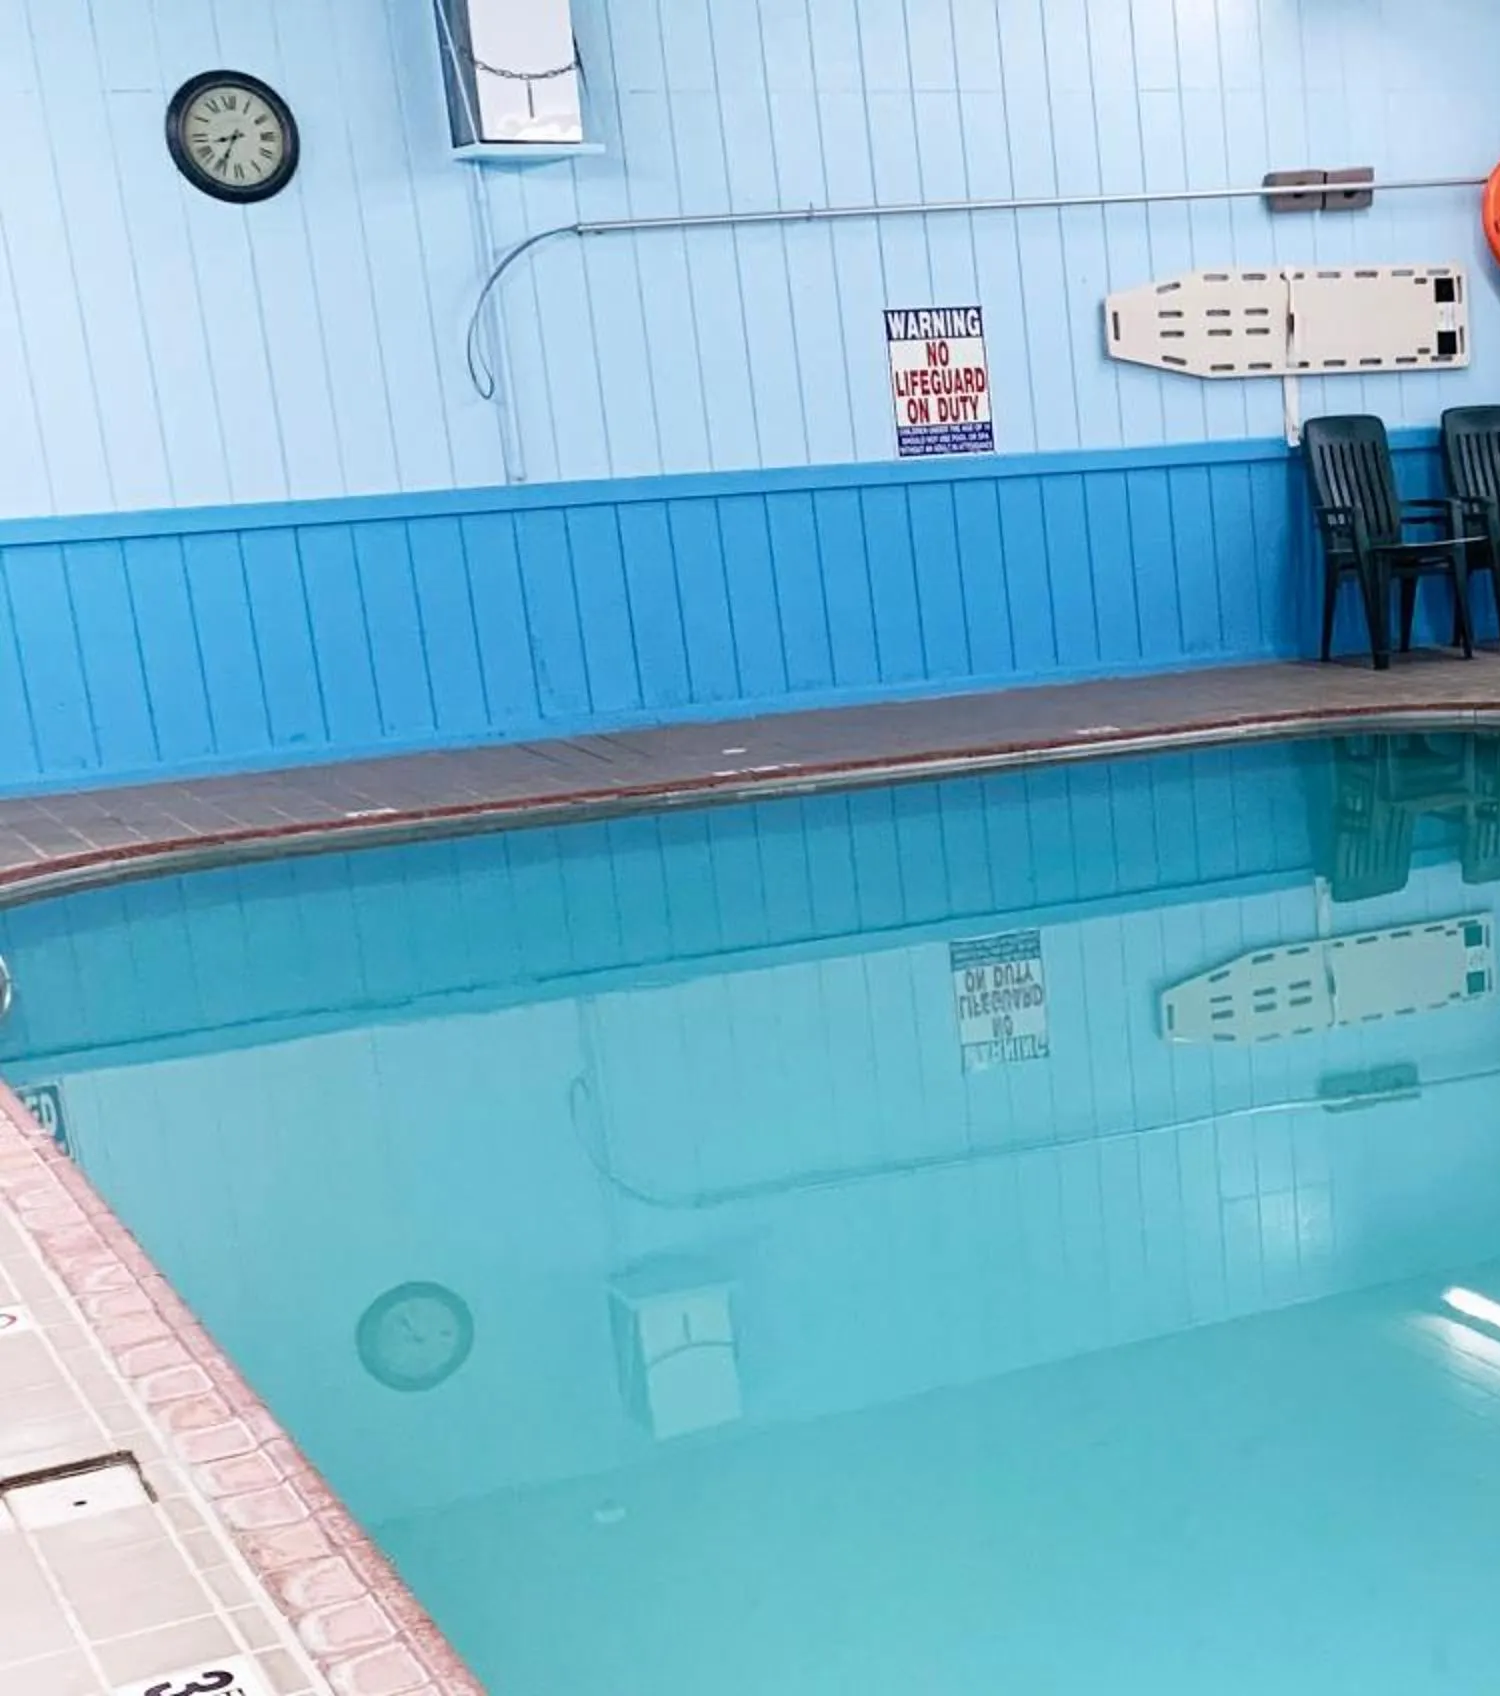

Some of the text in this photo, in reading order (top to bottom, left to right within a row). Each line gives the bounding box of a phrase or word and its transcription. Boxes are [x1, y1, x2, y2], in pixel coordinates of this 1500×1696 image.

[888, 309, 981, 339] WARNING
[926, 341, 949, 366] NO
[895, 368, 985, 397] LIFEGUARD
[907, 396, 979, 424] ON DUTY
